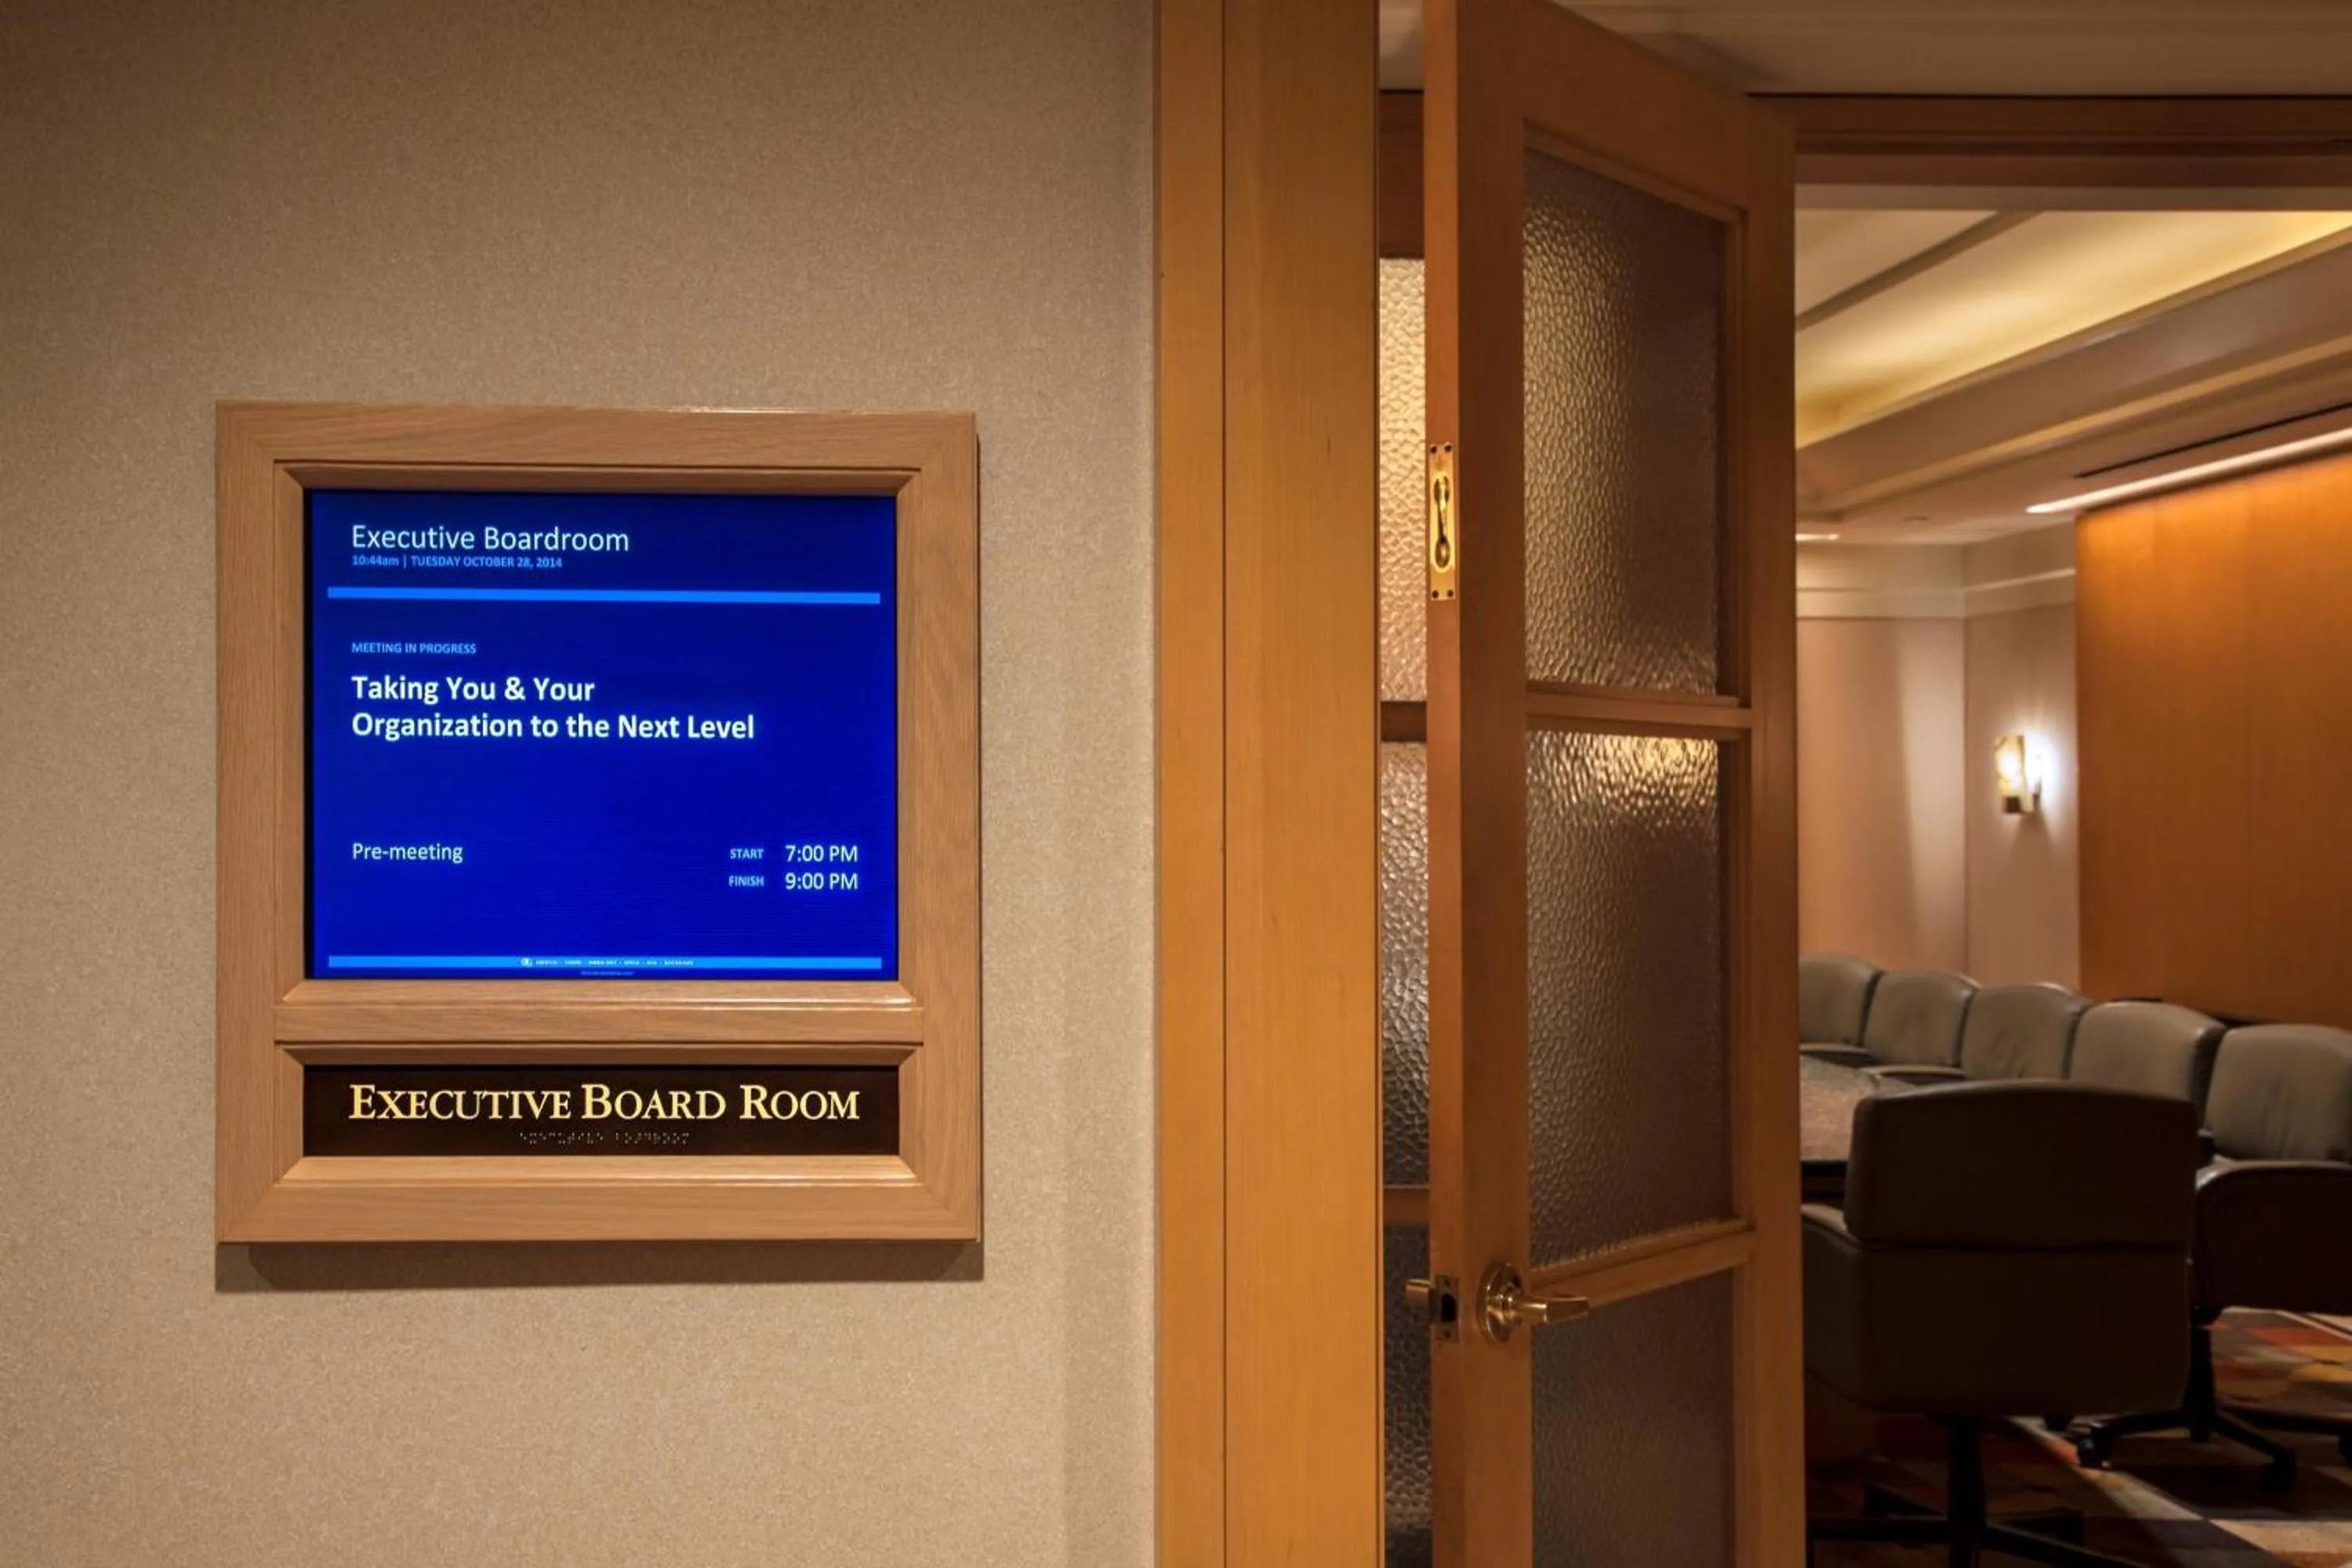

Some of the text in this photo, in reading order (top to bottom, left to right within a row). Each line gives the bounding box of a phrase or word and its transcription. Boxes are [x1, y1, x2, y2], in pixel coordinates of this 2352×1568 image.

[352, 524, 630, 552] Executive Boardroom
[352, 555, 399, 566] 10:44am
[411, 555, 461, 568] TUESDAY
[463, 556, 515, 568] OCTOBER
[517, 557, 534, 569] 28,
[536, 557, 563, 568] 2014
[351, 642, 477, 655] MEETING IN PROGRESS
[351, 674, 596, 706] Taking You & Your
[352, 712, 754, 742] Organization to the Next Level
[352, 842, 463, 865] Pre-meeting
[730, 844, 858, 863] START 7:00 PM
[728, 872, 858, 891] FINISH 9:00 PM
[349, 1083, 860, 1120] EXECUTIVE BOARD ROOM
